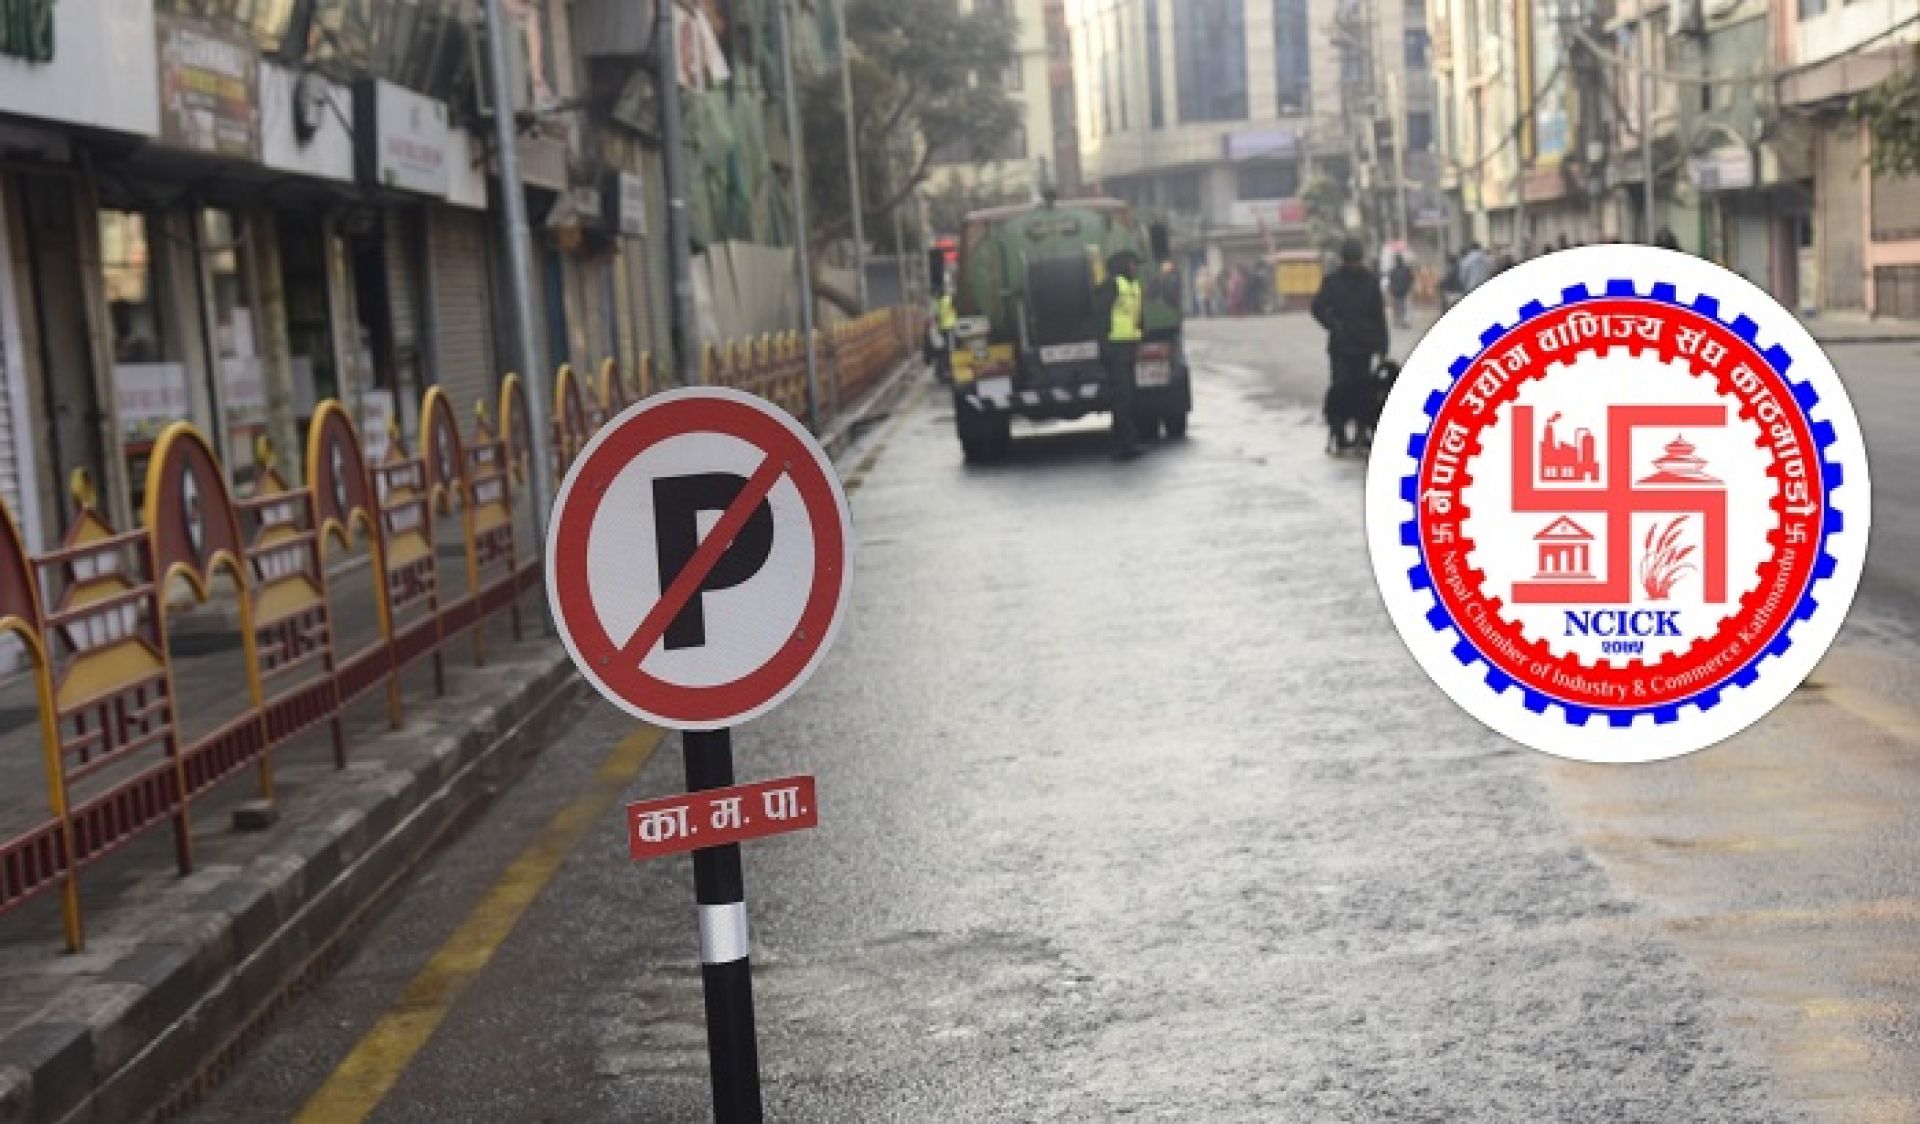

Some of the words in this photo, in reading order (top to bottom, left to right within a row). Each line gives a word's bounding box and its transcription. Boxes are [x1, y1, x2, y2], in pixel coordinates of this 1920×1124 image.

[652, 472, 774, 650] P
[638, 805, 698, 843] का.
[709, 796, 750, 829] म.
[761, 786, 807, 820] पा.
